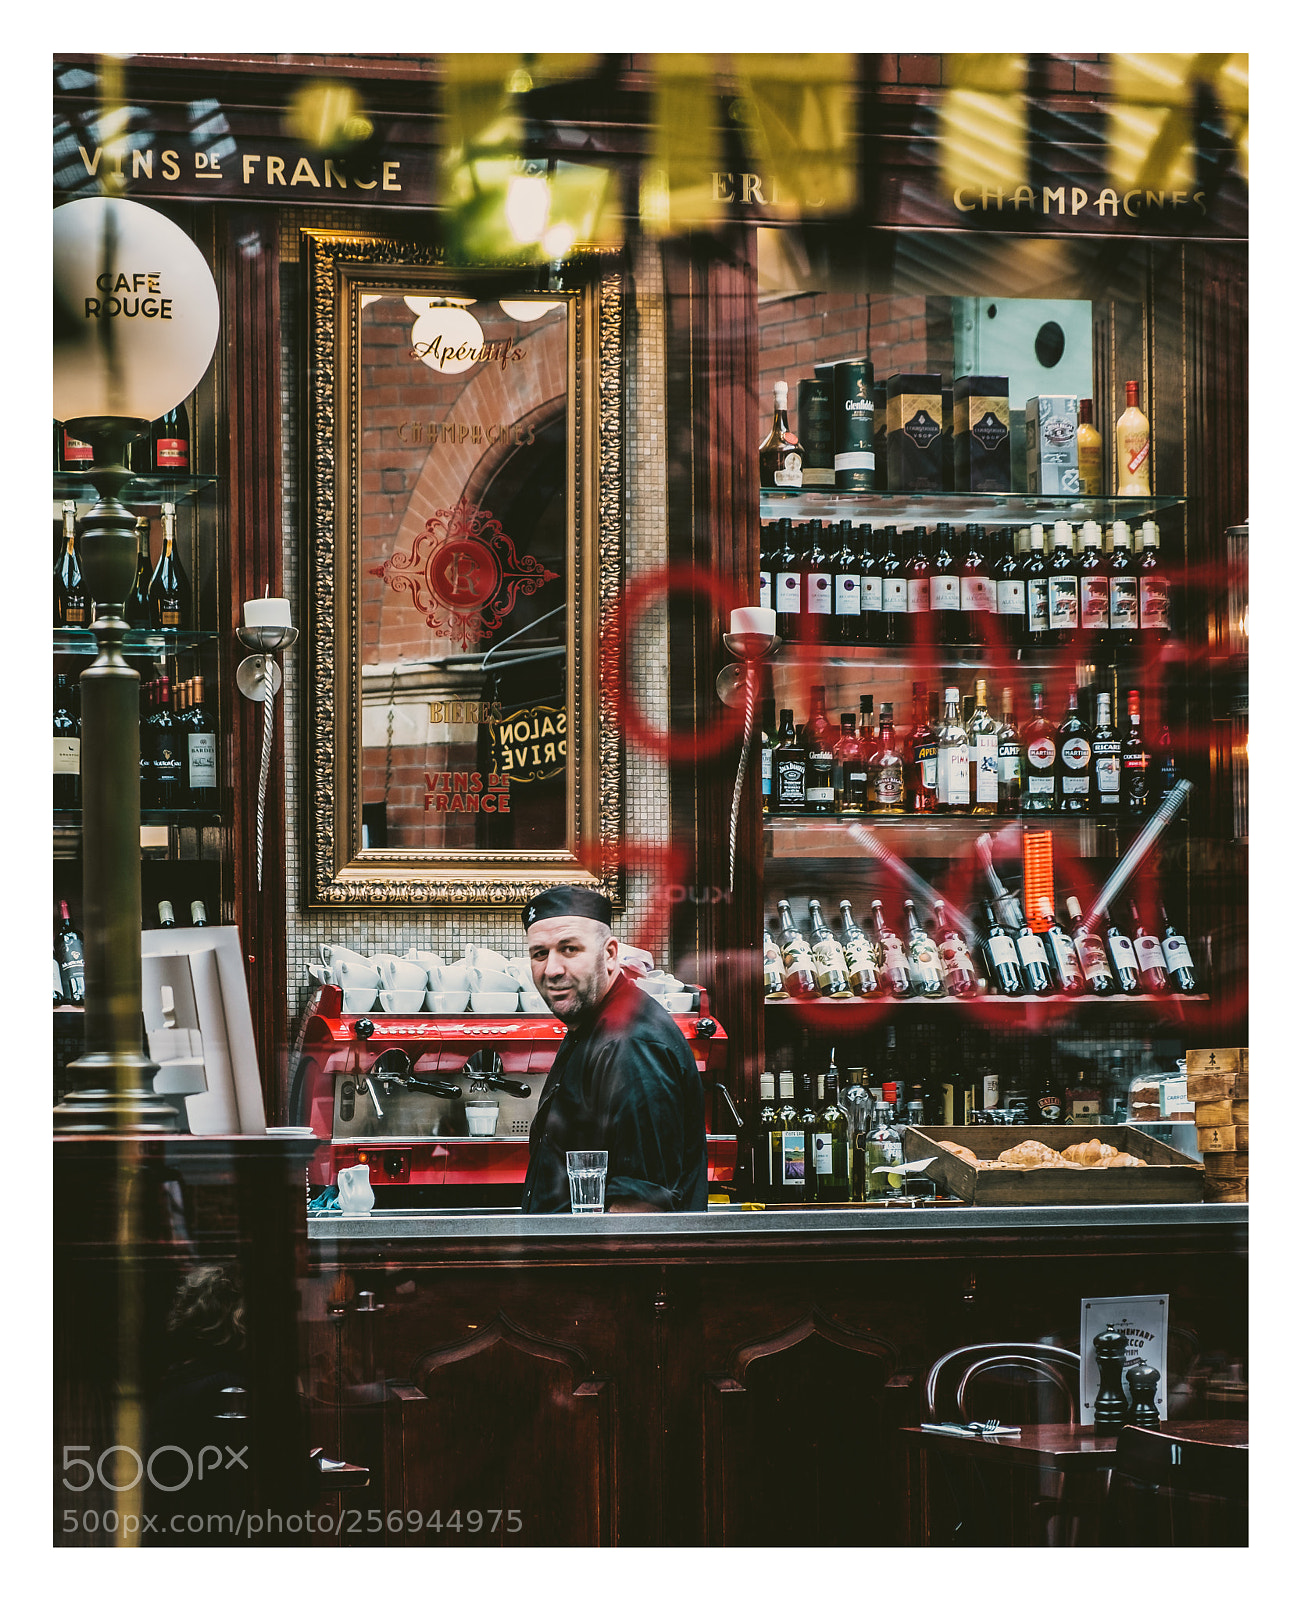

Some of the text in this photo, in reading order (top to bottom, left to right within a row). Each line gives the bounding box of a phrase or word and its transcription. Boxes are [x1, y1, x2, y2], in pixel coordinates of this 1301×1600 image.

[79, 146, 181, 181] VINS
[195, 152, 222, 170] DE
[85, 297, 173, 319] ROUGE
[409, 334, 527, 371] Apéritifs
[396, 420, 536, 446] CHAMPAGNES
[429, 694, 502, 724] BIÈRES
[424, 772, 511, 793] VINS DE
[424, 794, 511, 813] FRANCE
